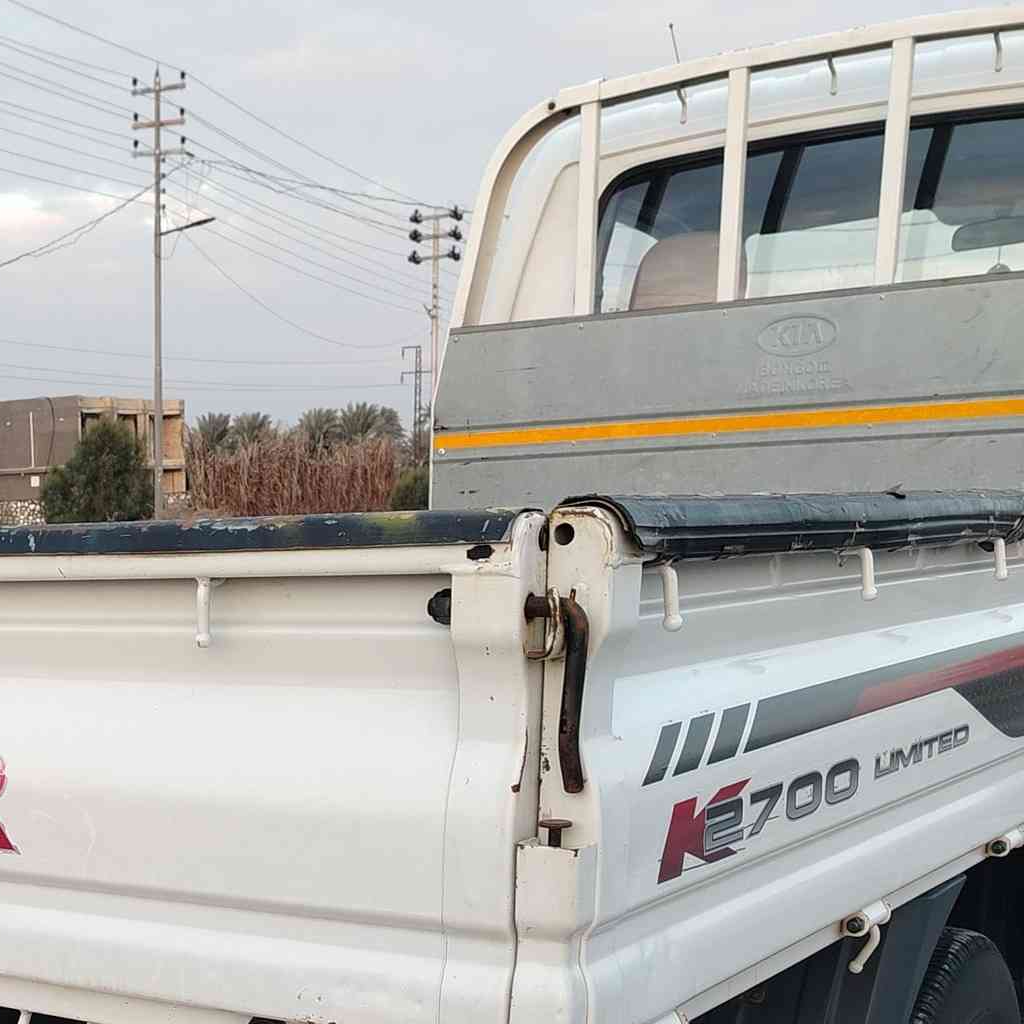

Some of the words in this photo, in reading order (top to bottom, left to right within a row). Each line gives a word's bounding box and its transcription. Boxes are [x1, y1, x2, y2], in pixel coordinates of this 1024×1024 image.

[769, 319, 825, 346] KIA
[657, 758, 860, 884] K2700
[873, 723, 971, 781] LIMITED
